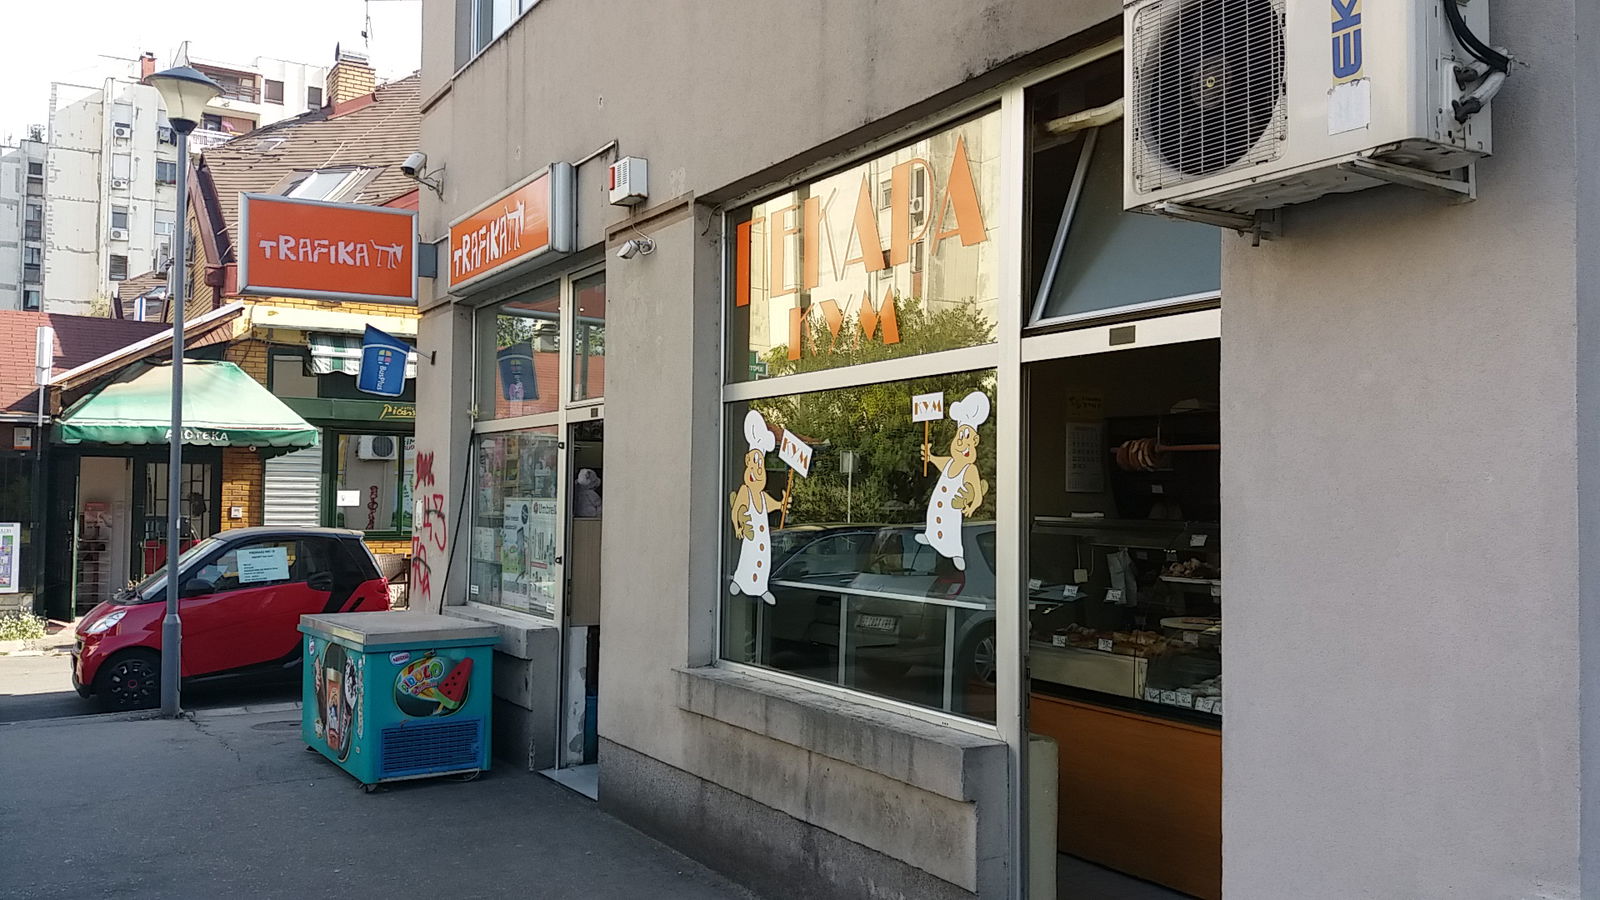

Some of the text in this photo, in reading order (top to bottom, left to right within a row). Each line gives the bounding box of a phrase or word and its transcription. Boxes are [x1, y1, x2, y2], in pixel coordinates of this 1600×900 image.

[736, 134, 989, 308] ПЕКАРА
[258, 234, 370, 267] TRAFIKA
[453, 216, 508, 278] TRAFIKA
[788, 284, 901, 361] КУМ
[914, 399, 942, 416] КУМ
[164, 428, 229, 441] АОТЕКА
[781, 436, 808, 470] КУМ
